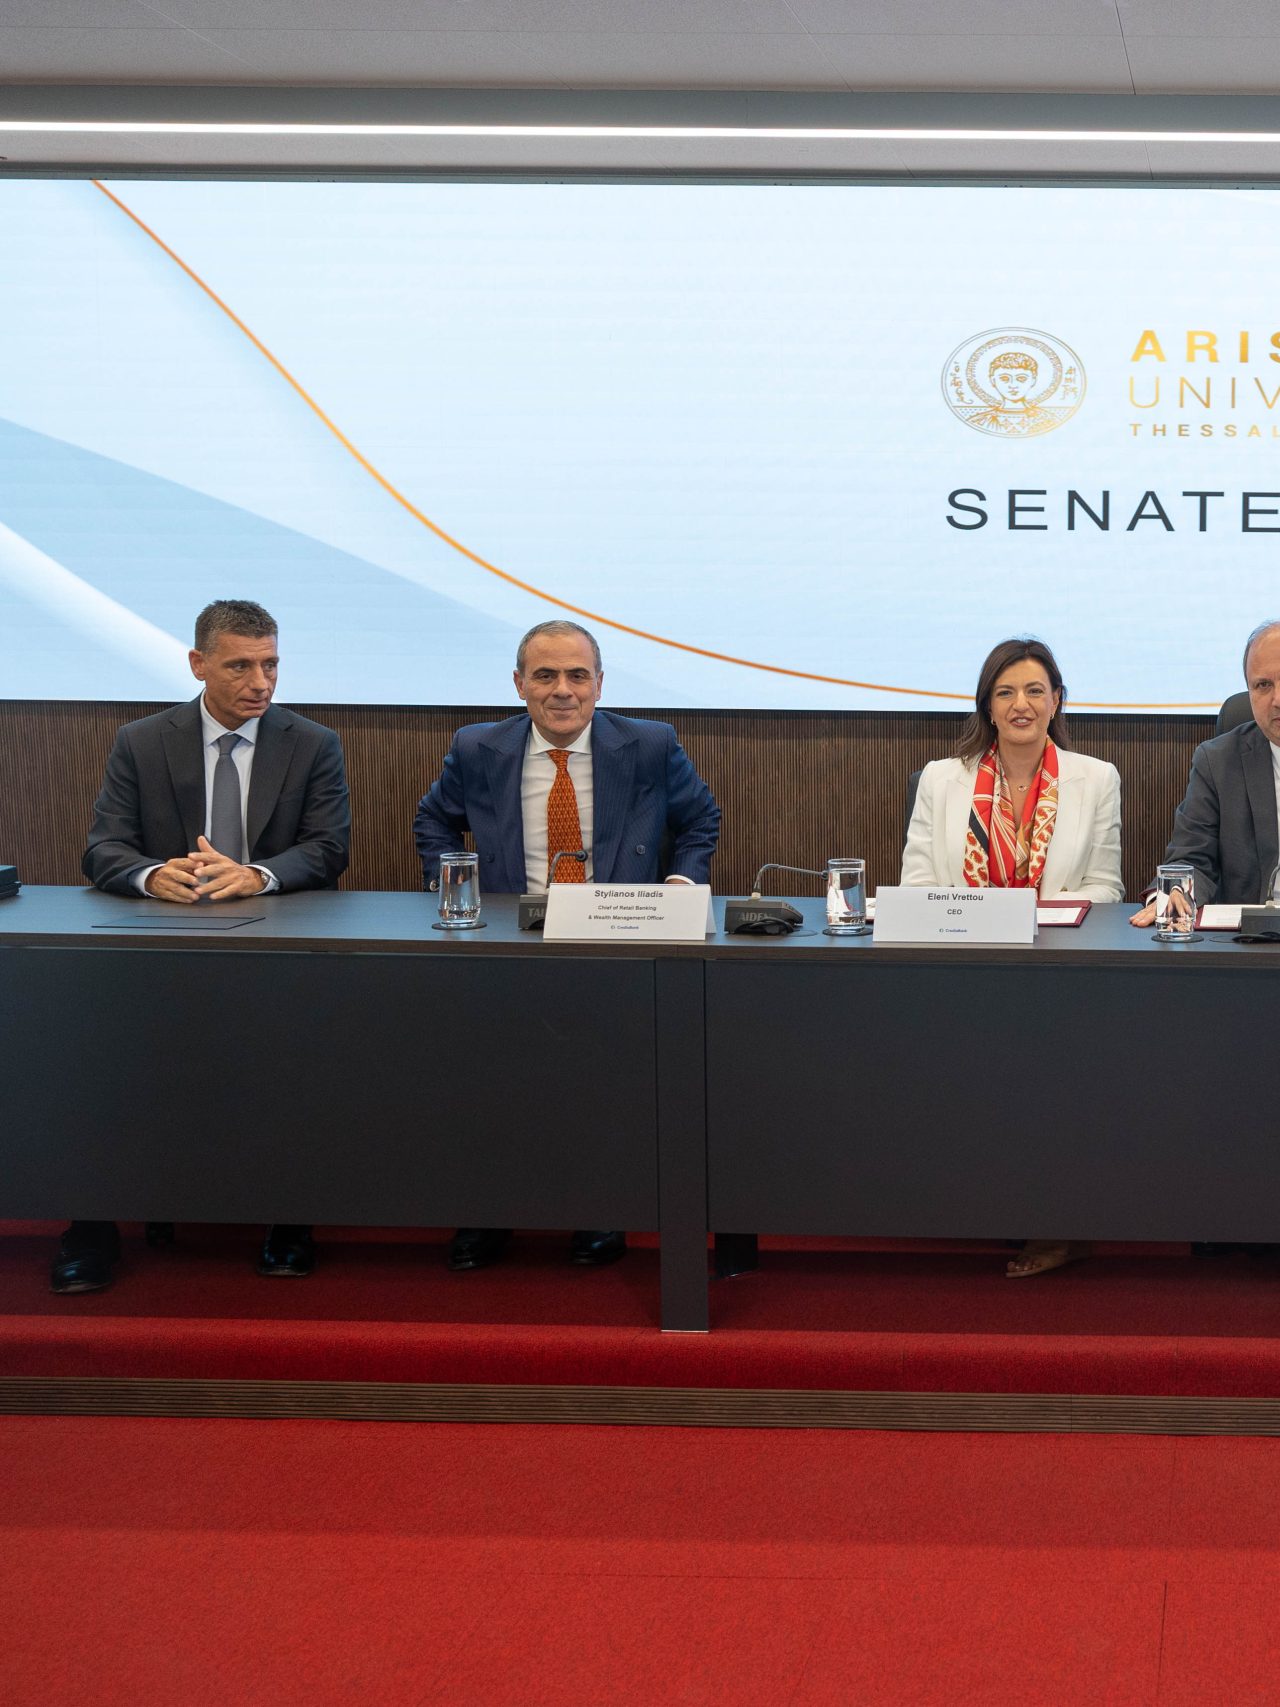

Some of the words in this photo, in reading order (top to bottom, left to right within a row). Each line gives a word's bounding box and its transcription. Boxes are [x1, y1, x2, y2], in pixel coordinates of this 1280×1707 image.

[946, 489, 1280, 532] SENATE
[594, 889, 636, 899] Stylianos
[637, 890, 664, 898] Iliadis
[927, 892, 950, 901] Eleni
[951, 893, 984, 901] Vrettou
[528, 908, 546, 918] TAI
[946, 908, 963, 916] CEO
[612, 914, 646, 922] Management
